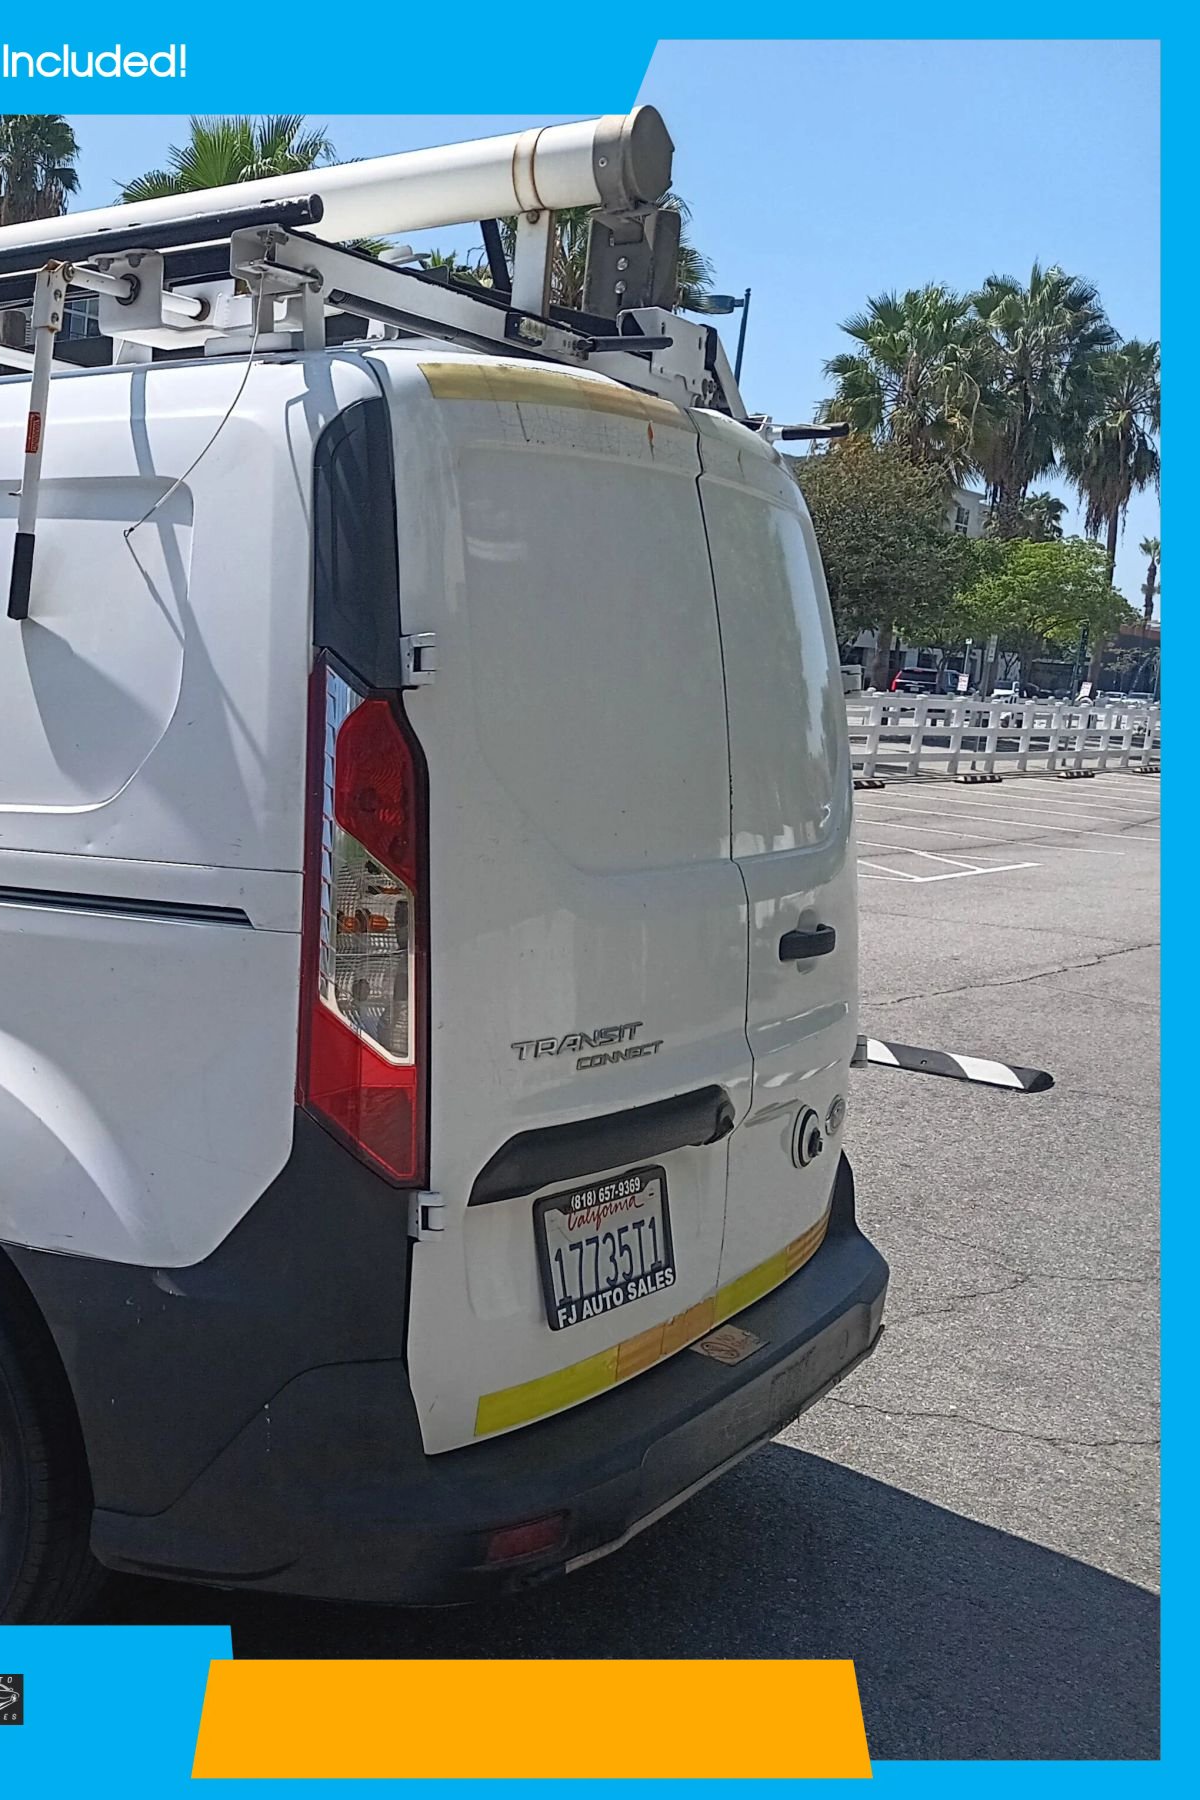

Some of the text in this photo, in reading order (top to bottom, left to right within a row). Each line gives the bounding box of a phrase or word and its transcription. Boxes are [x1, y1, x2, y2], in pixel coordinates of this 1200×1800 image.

[511, 1021, 644, 1061] TRANSIT
[576, 1039, 664, 1071] CONNECT
[571, 1176, 641, 1211] (818) 657-9369
[567, 1195, 645, 1232] California
[554, 1216, 662, 1304] 17735T1
[557, 1267, 674, 1329] FJ AUTO SALES
